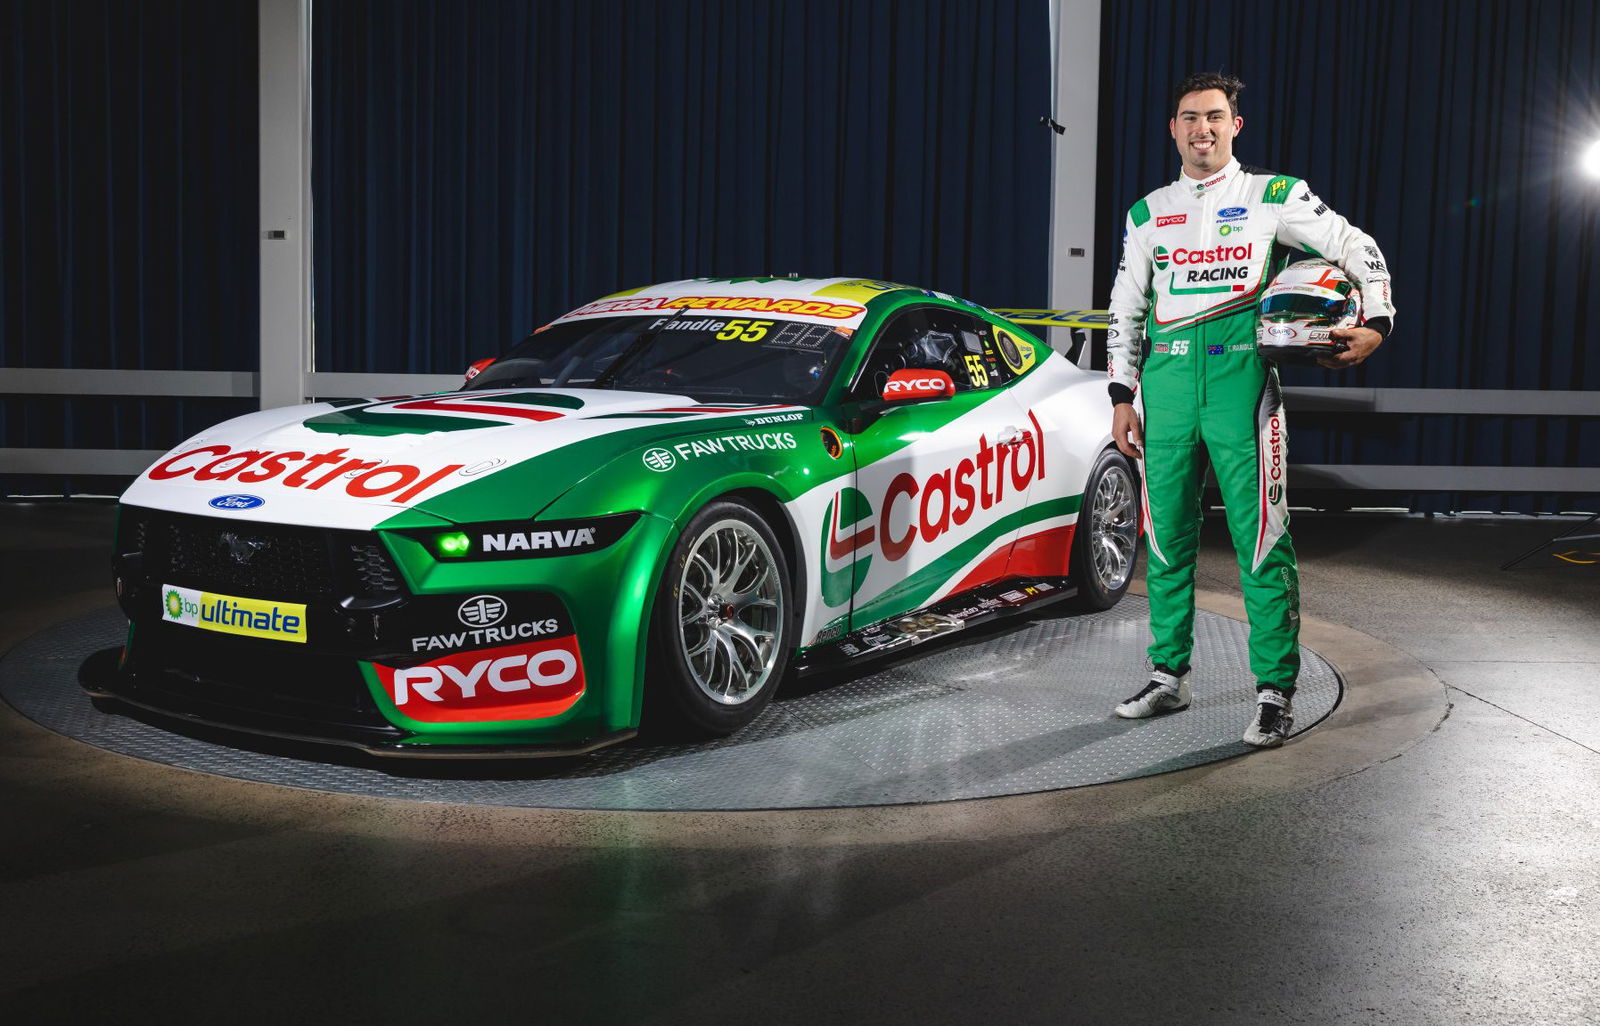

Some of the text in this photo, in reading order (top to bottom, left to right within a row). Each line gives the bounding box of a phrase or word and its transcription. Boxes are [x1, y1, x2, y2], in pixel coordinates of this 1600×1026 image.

[1158, 216, 1186, 226] RYCO
[1172, 242, 1253, 265] Castrol
[1187, 266, 1249, 282] RACING
[660, 296, 867, 320] REWARDS
[715, 319, 774, 343] 55
[1170, 340, 1190, 355] 55
[964, 354, 989, 388] 55
[884, 377, 946, 393] RYCO
[757, 412, 804, 425] DUNLOP
[674, 432, 797, 460] FAW TRUCKS
[148, 444, 466, 504] Castrol
[880, 408, 1046, 562] Castrol
[215, 496, 256, 509] Ford
[184, 599, 300, 634] bp ultimate
[411, 617, 559, 651] FAW TRUCKS
[394, 648, 577, 706] RYCO
